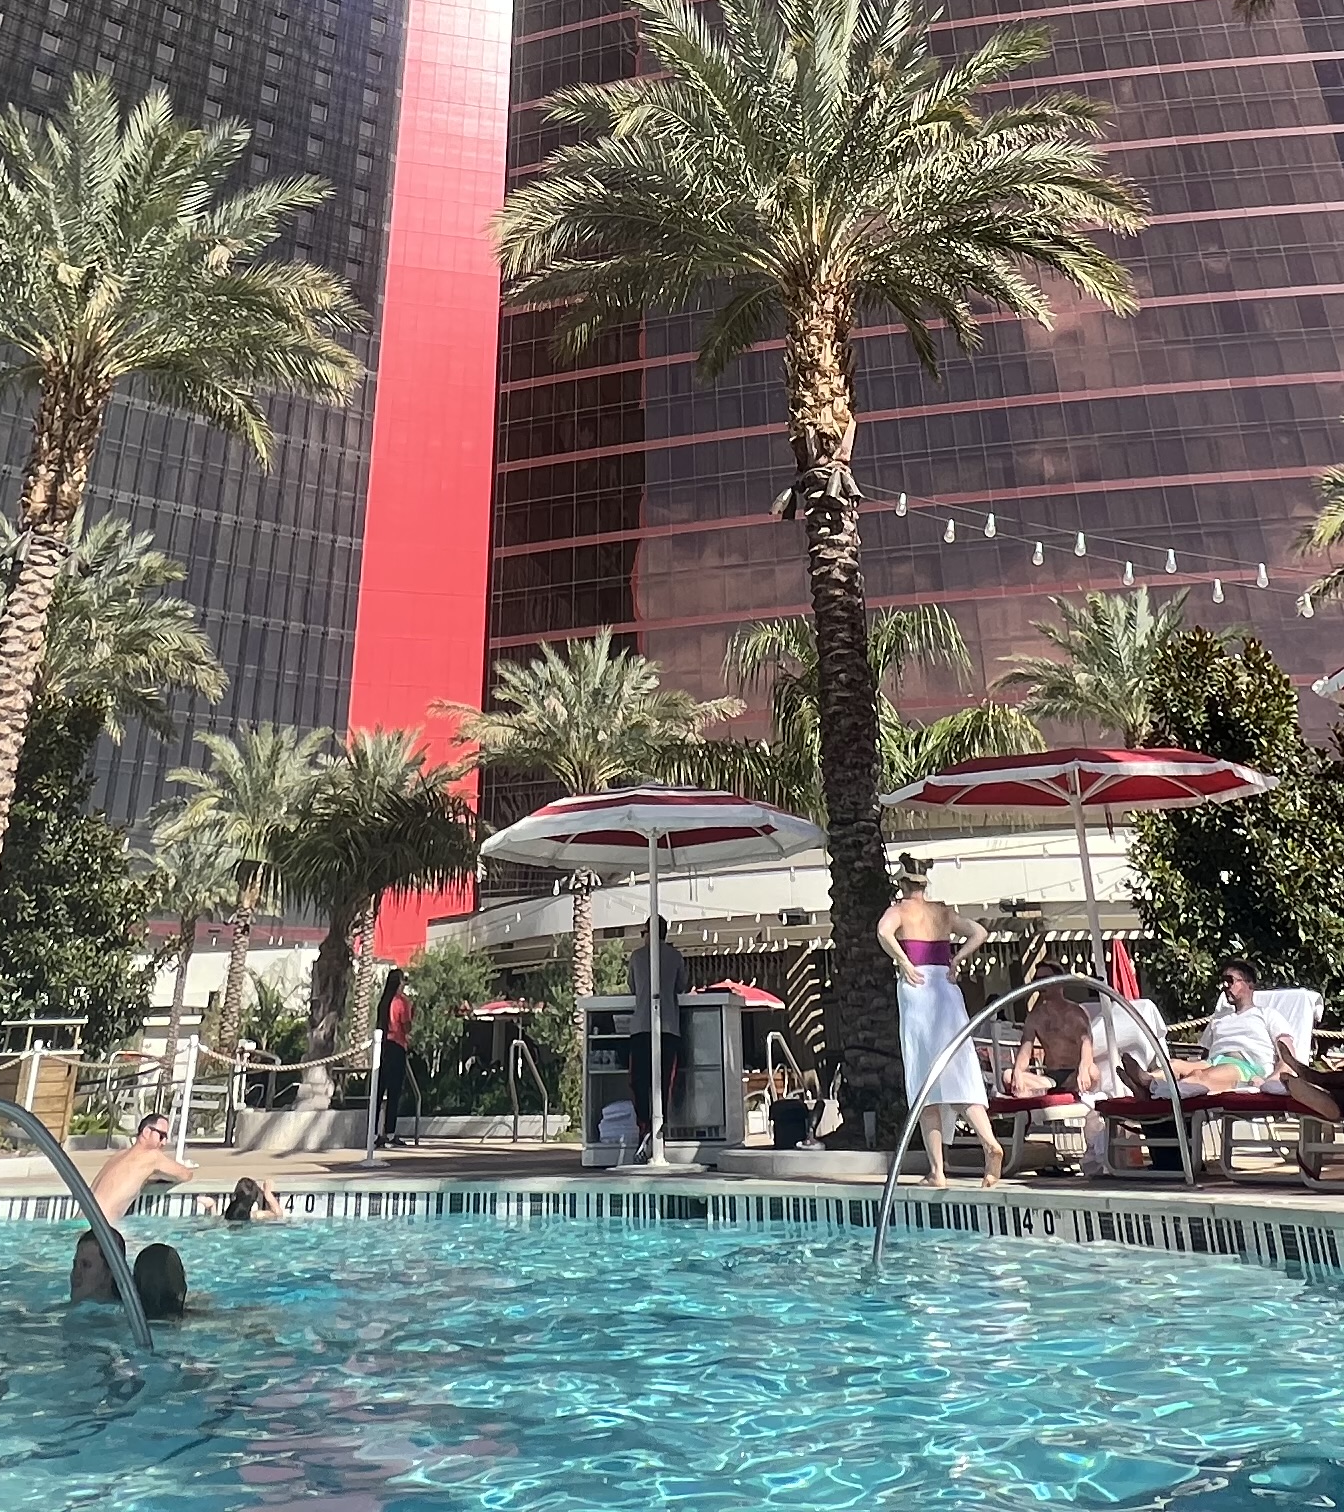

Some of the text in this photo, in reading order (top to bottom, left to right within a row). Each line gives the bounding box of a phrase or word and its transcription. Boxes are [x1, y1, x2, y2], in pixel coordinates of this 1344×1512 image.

[284, 1193, 295, 1214] 4
[1022, 1207, 1034, 1235] 4
[1043, 1209, 1055, 1236] 0
